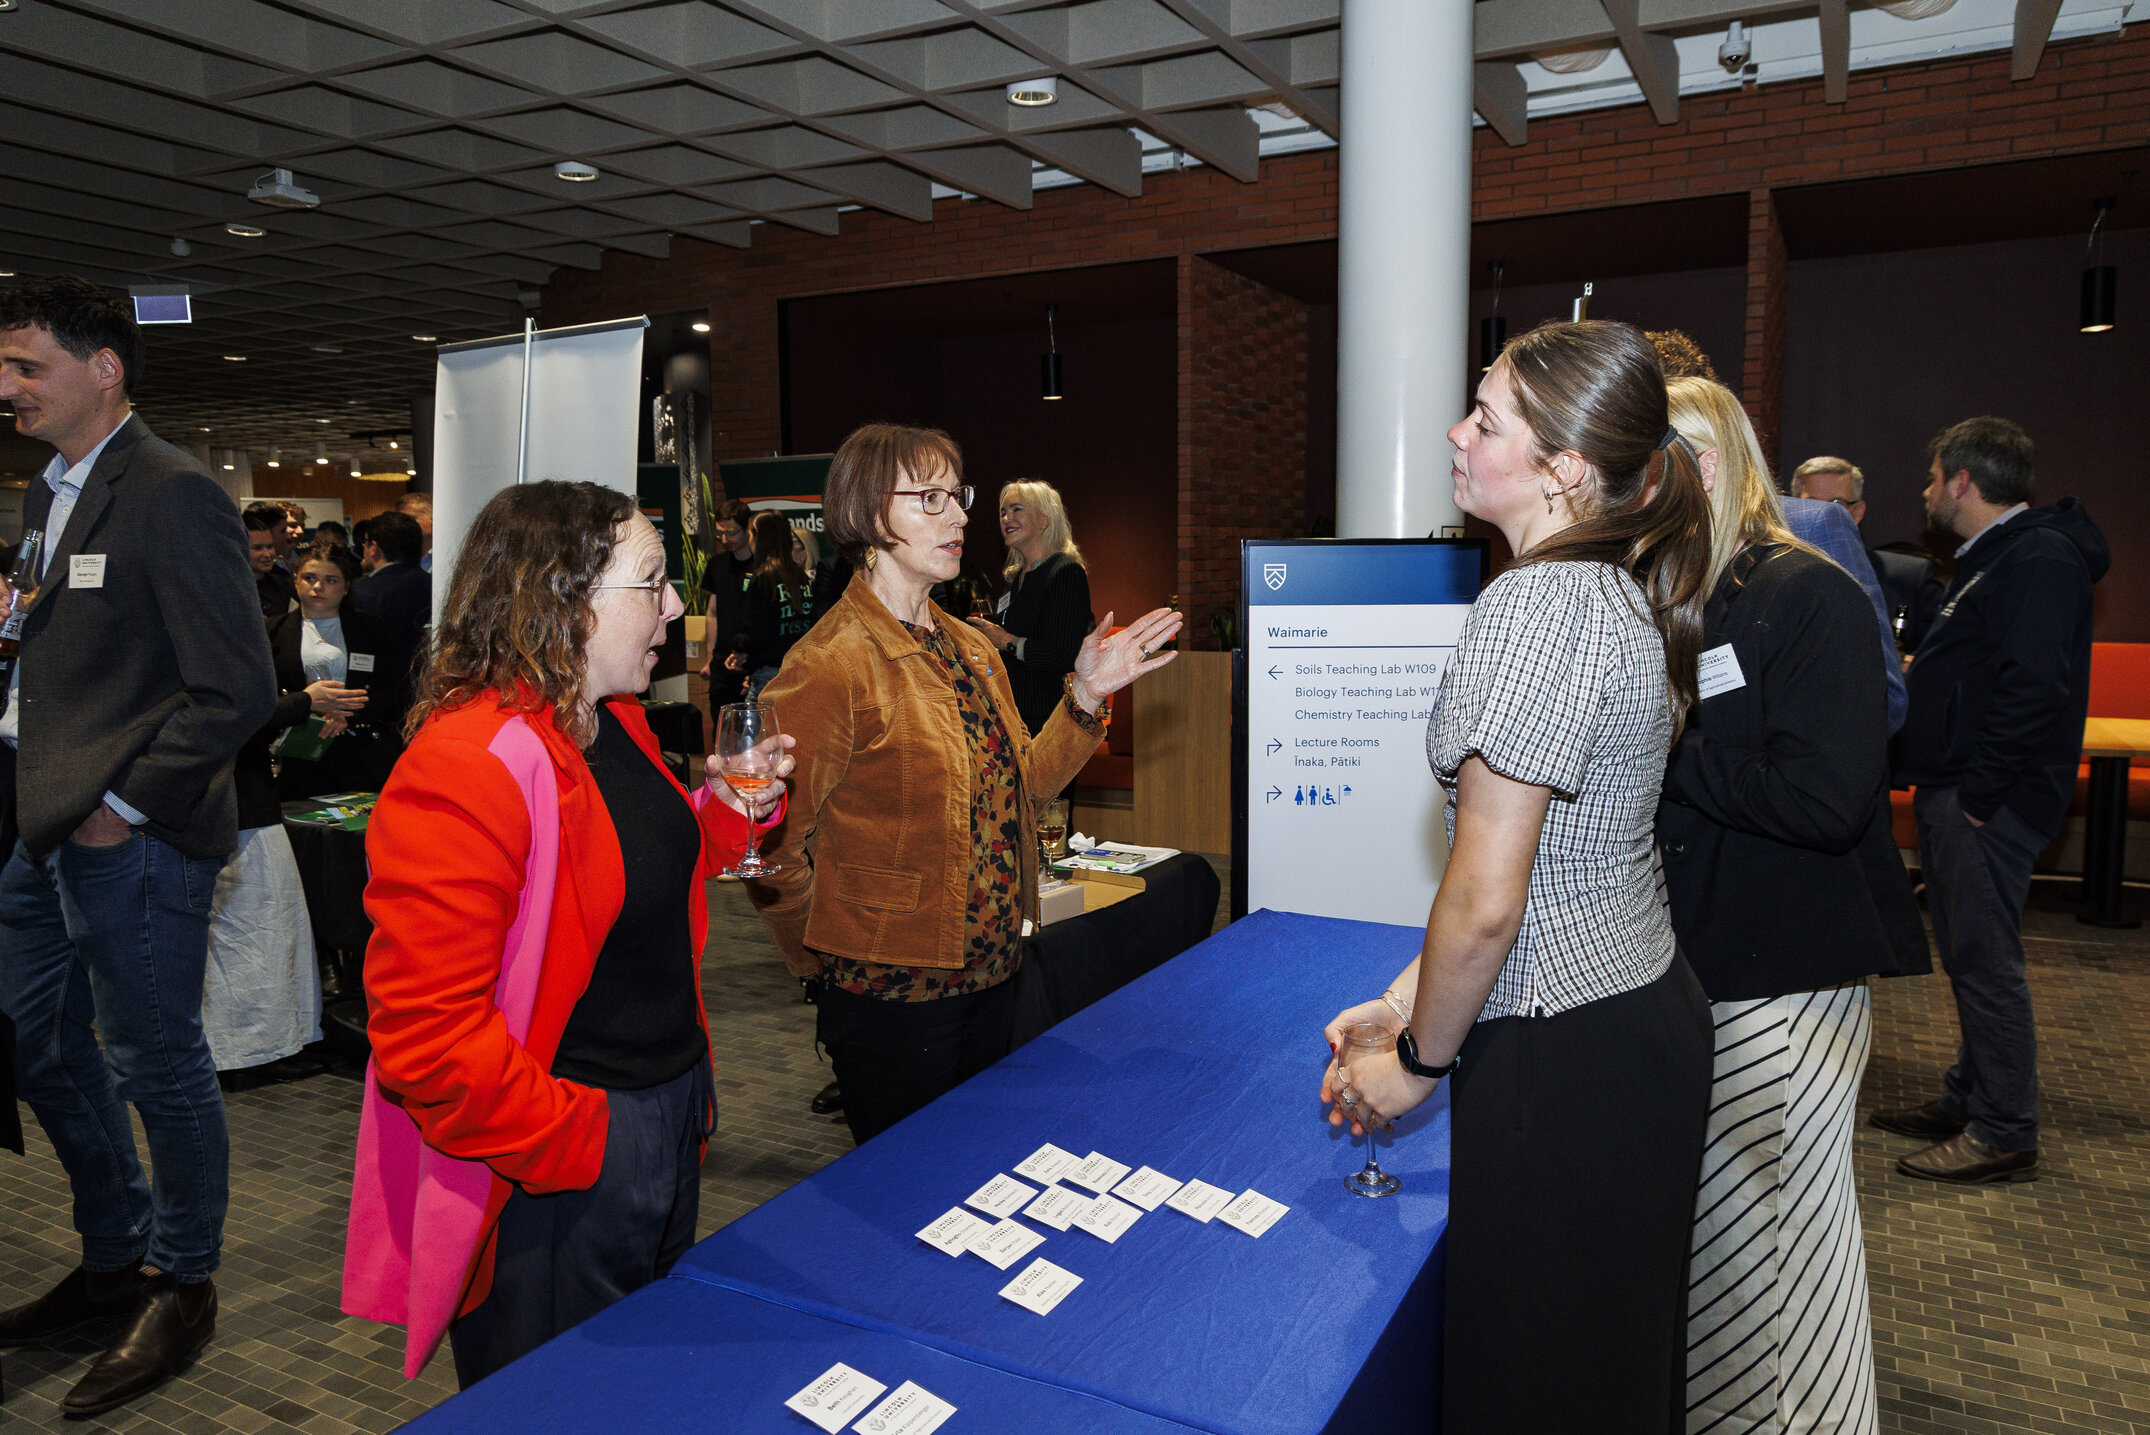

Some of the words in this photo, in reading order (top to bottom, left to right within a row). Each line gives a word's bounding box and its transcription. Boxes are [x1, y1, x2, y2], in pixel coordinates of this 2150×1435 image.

[1267, 627, 1328, 638] Waimarie
[1295, 664, 1322, 675] Soils
[1326, 664, 1377, 676] Teaching
[1381, 664, 1401, 674] Lab
[1404, 664, 1437, 674] W109
[1295, 687, 1337, 699] Biology
[1341, 686, 1392, 699] Teaching
[1396, 686, 1417, 697] Lab
[1295, 709, 1352, 721] Chemistry
[1356, 709, 1408, 721] Teaching
[1411, 709, 1432, 719] Lab
[1295, 737, 1338, 747] Lecture
[1341, 737, 1380, 747] Rooms
[1294, 755, 1327, 767] Īnaka,
[1331, 756, 1361, 767] Pātiki
[1024, 1265, 1048, 1286] UNIVERSITY
[816, 1371, 848, 1396] UNIVERSITY
[884, 1391, 917, 1419] UNIVERSITY
